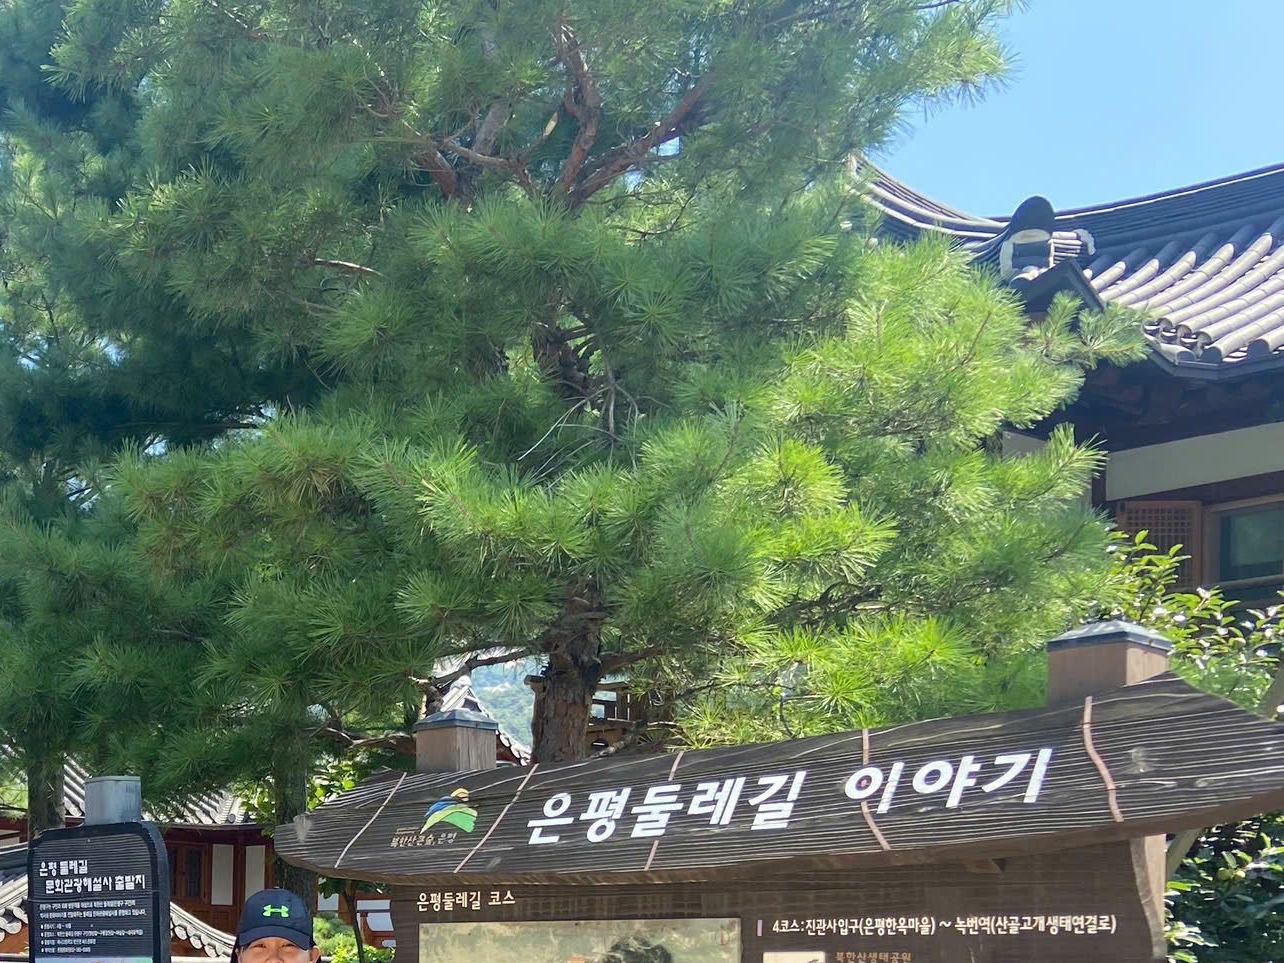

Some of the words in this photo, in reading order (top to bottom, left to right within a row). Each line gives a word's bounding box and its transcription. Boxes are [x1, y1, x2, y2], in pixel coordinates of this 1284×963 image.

[526, 770, 808, 845] 은평둘레길
[844, 748, 1053, 815] 이야기
[45, 876, 113, 894] 문화관광해설사
[114, 874, 146, 891] 출발지
[416, 892, 481, 912] 은평둘레길
[488, 890, 516, 906] 코스
